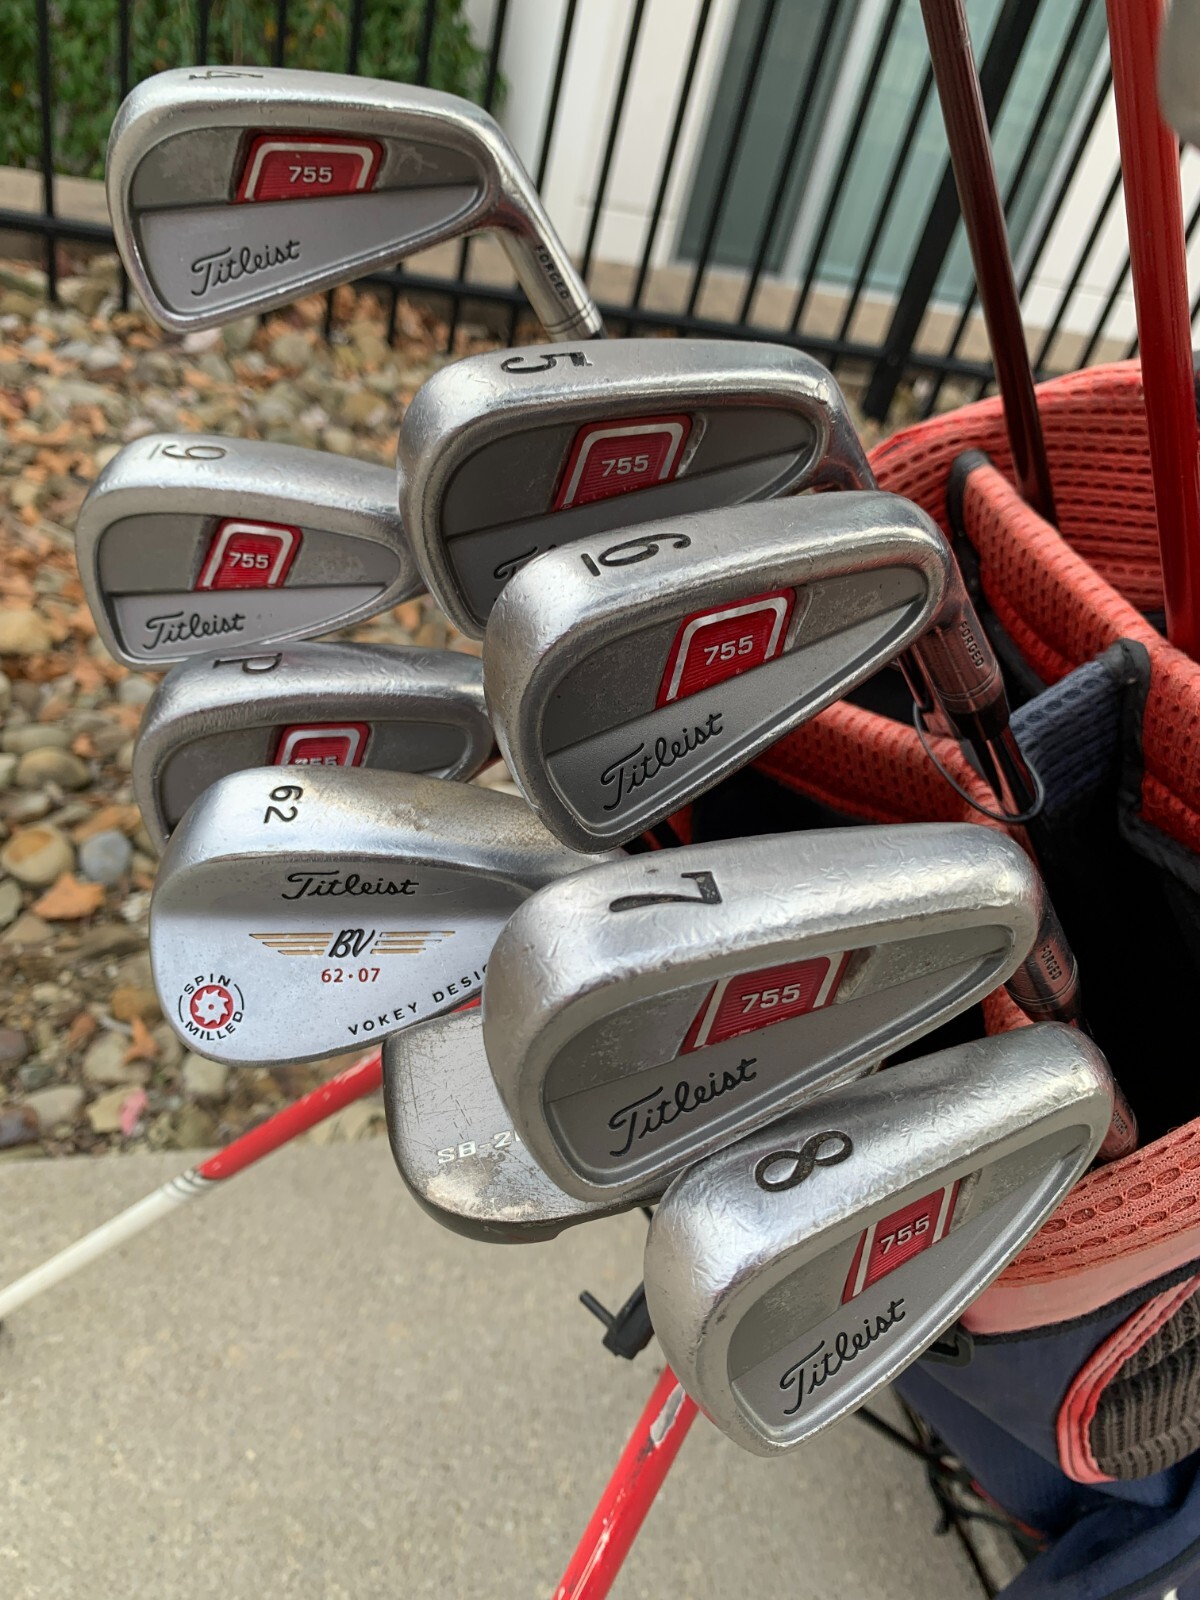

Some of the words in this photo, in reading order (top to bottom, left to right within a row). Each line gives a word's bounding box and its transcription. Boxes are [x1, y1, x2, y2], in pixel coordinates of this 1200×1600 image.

[288, 166, 333, 184] 755
[190, 239, 301, 297] Titleist
[535, 244, 570, 300] FORGED
[500, 350, 594, 375] 5
[601, 453, 650, 478] 755
[228, 552, 270, 570] 755
[598, 531, 692, 568] 6
[142, 609, 247, 650] Titleist
[961, 620, 985, 668] FORGED
[213, 652, 284, 676] P
[703, 634, 755, 666] 755
[600, 712, 724, 810] Titleist
[263, 784, 304, 824] 62
[281, 869, 420, 901] Titleist
[608, 870, 723, 914] 7
[327, 928, 377, 959] BV
[1041, 944, 1063, 981] FORGED
[183, 972, 232, 995] SPIN
[740, 982, 801, 1015] 755
[184, 1010, 244, 1041] MILLED
[347, 1001, 418, 1036] VOKEY
[608, 1057, 758, 1158] Titleist
[754, 1129, 853, 1193] 8
[879, 1212, 931, 1256] 755
[778, 1297, 907, 1416] Titleist
